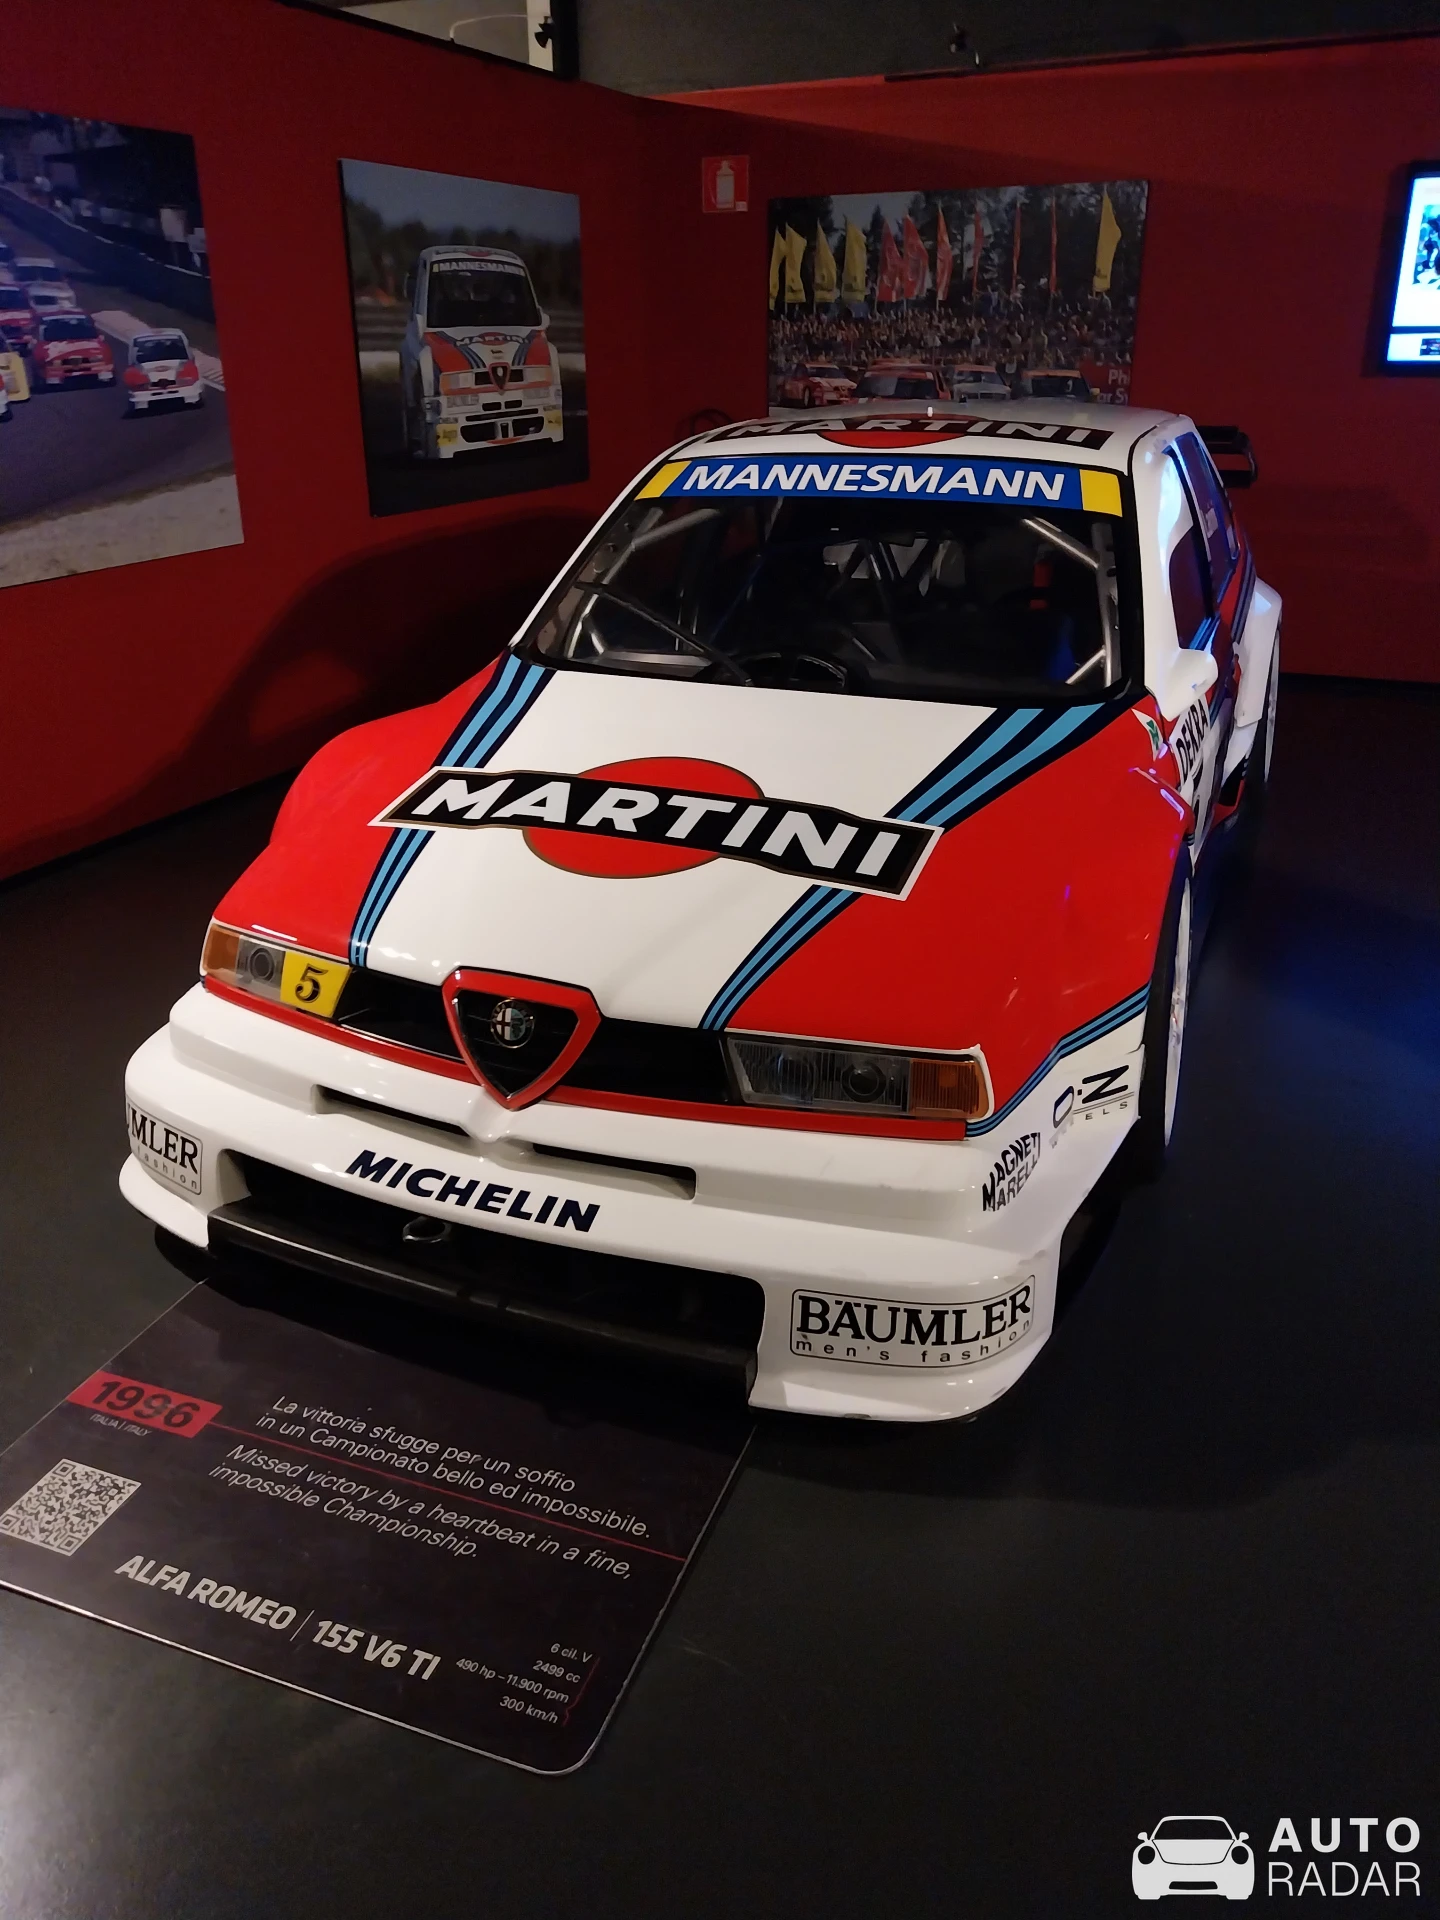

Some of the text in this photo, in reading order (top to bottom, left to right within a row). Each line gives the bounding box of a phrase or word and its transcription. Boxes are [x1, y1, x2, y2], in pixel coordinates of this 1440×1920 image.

[727, 419, 1092, 443] MARTINI
[682, 464, 1065, 501] MANNESMANN
[1176, 699, 1209, 786] DEKRA
[410, 778, 901, 878] MARTINI
[295, 963, 328, 1004] 5
[127, 1103, 198, 1174] MLER
[1049, 1101, 1128, 1149] ELS
[345, 1149, 601, 1233] MICHELIN
[982, 1132, 1041, 1212] MAGNETI
[795, 1318, 1031, 1363] men's fashion
[796, 1285, 1031, 1346] BÄUMLER
[90, 1414, 152, 1437] ITALIA ITALY
[92, 1381, 200, 1428] 1996
[272, 1396, 576, 1492] La vittoria sfugge per un soffio
[256, 1412, 650, 1538] in un Campionato bello ed impossibile.
[208, 1462, 477, 1558] impossible Championship.
[226, 1444, 631, 1580] Missed victory by a heartbeat in a fine,
[114, 1555, 442, 1681] ALFA ROMEO 155 V6 TI
[532, 1659, 581, 1684] 2499 cc
[550, 1643, 593, 1663] 6 cil. V
[456, 1658, 479, 1673] 490
[478, 1665, 496, 1680] hp
[543, 1687, 569, 1704] rpm
[499, 1696, 559, 1724] 300 km/h
